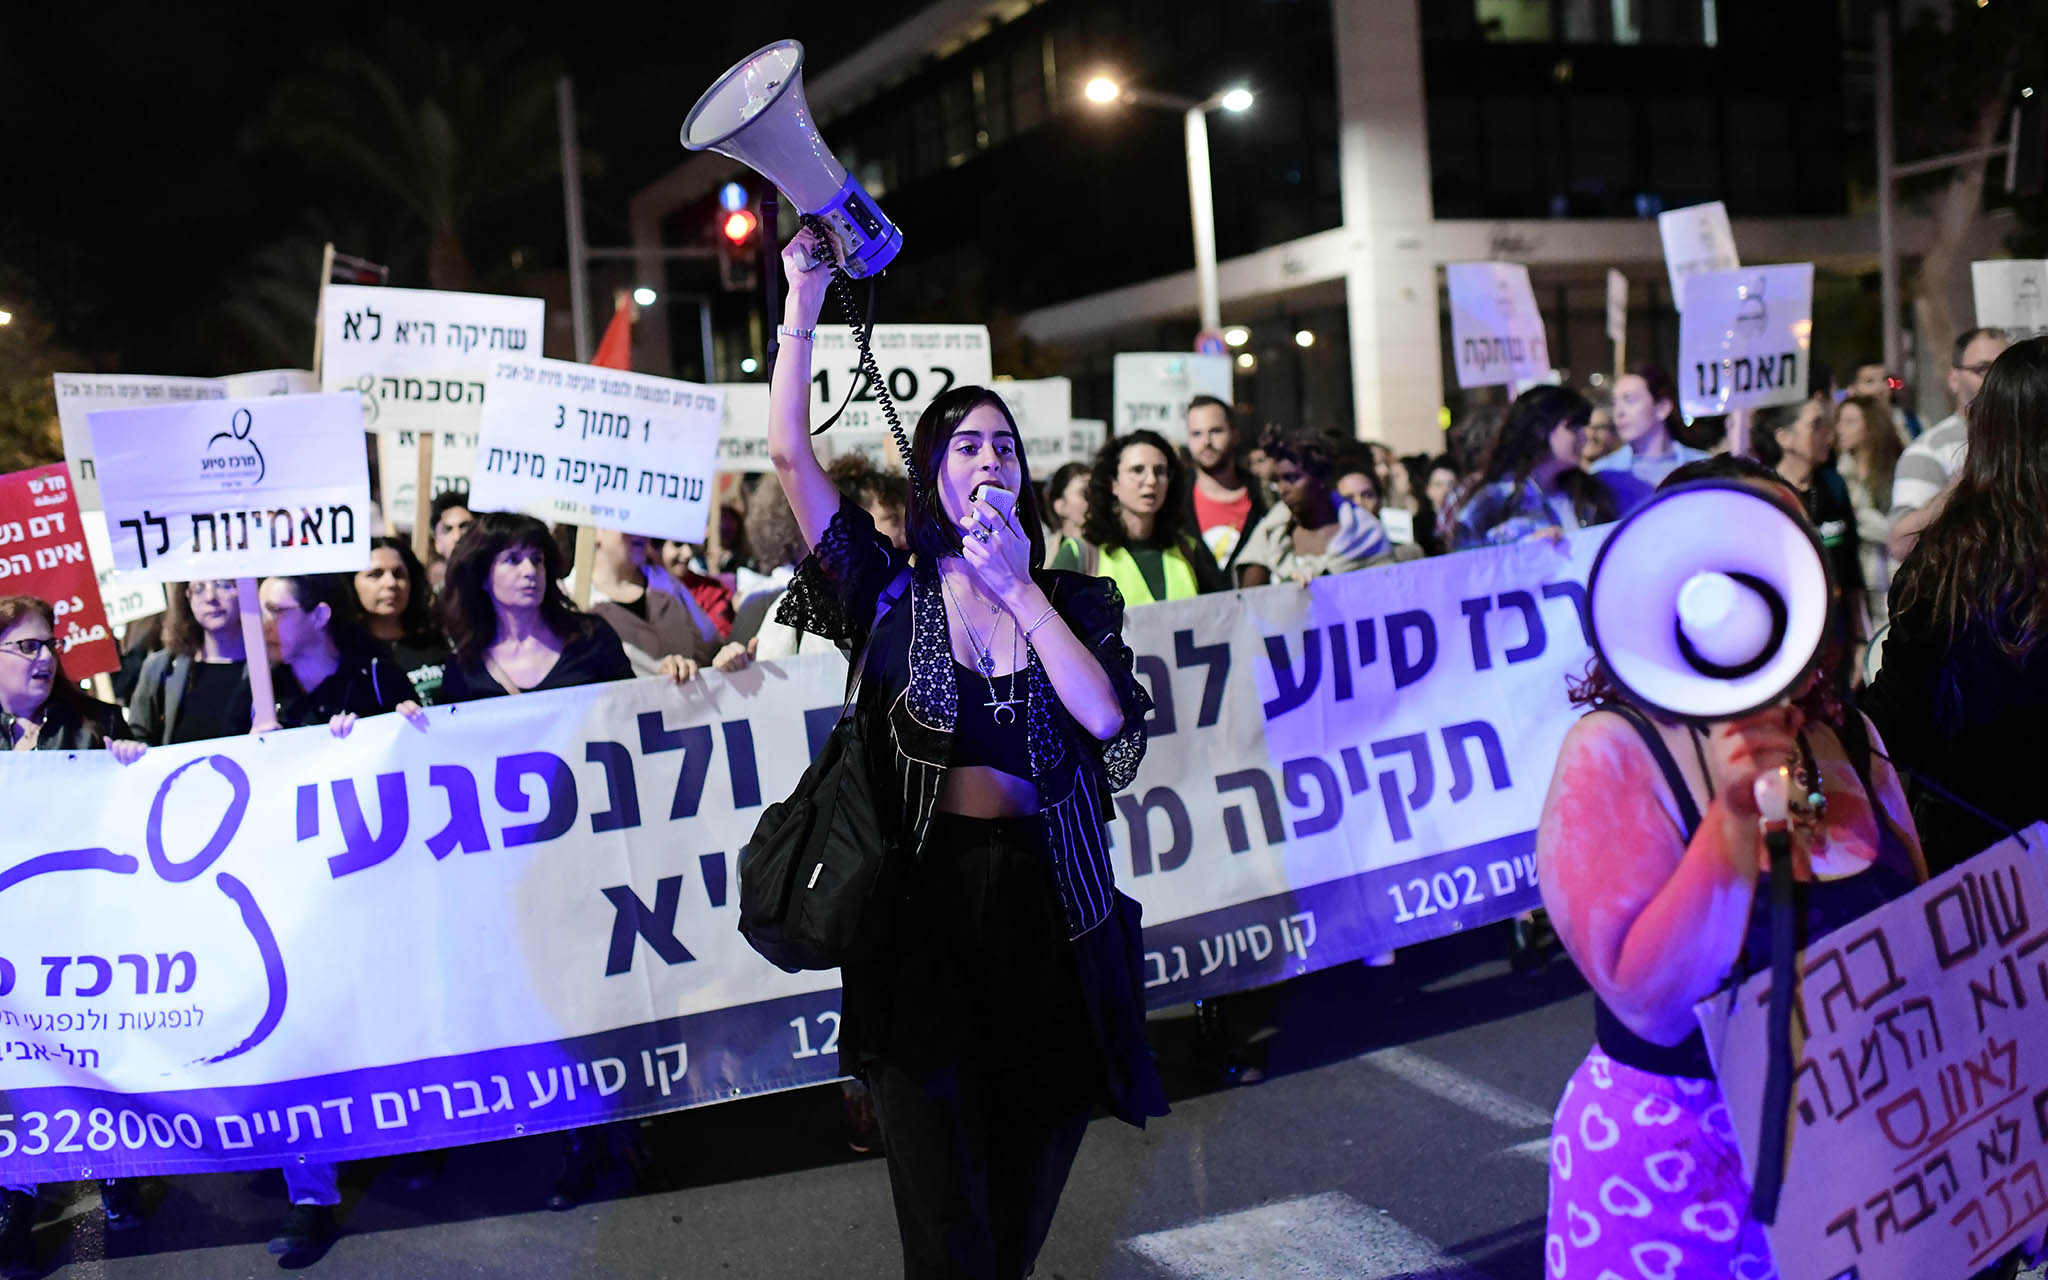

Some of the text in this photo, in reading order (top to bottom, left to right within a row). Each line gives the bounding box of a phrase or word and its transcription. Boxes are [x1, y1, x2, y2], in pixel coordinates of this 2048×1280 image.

[343, 306, 527, 354] שתיקה היא לא
[381, 376, 485, 404] הסכמה
[812, 366, 956, 403] 1202
[1695, 352, 1797, 398] תאמינו
[554, 404, 566, 429] 3
[577, 407, 630, 440] מתוך
[201, 455, 256, 470] מרכז סיוע
[487, 447, 704, 502] עוברת תקיפה מינית
[28, 512, 65, 538] דם
[120, 504, 355, 568] מאמינות לך
[35, 541, 85, 570] אינו
[1461, 579, 1592, 672] רכז
[1262, 608, 1439, 720] סיוע
[296, 711, 762, 879] ולנפגעי
[1215, 719, 1514, 854] תקיפה
[1387, 850, 1541, 925] שים 1202
[1279, 910, 1318, 961] קו
[1925, 865, 2030, 970] שום
[41, 950, 197, 998] מרכז
[1199, 924, 1274, 976] סיוע
[23, 1008, 108, 1032] ולנפגעי
[118, 1004, 205, 1031] לנפגעות
[0, 1041, 99, 1069] תל-אבי
[642, 1043, 688, 1096] קו
[1793, 996, 1944, 1126] הזמנה
[371, 1077, 514, 1130] גברים
[527, 1057, 627, 1109] סיוע
[1876, 1036, 2019, 1151] לאונס
[216, 1095, 354, 1150] דתיים
[1976, 1113, 2021, 1180] לא
[1825, 1150, 1960, 1254] הבגד
[1950, 1160, 2048, 1252] הזה
